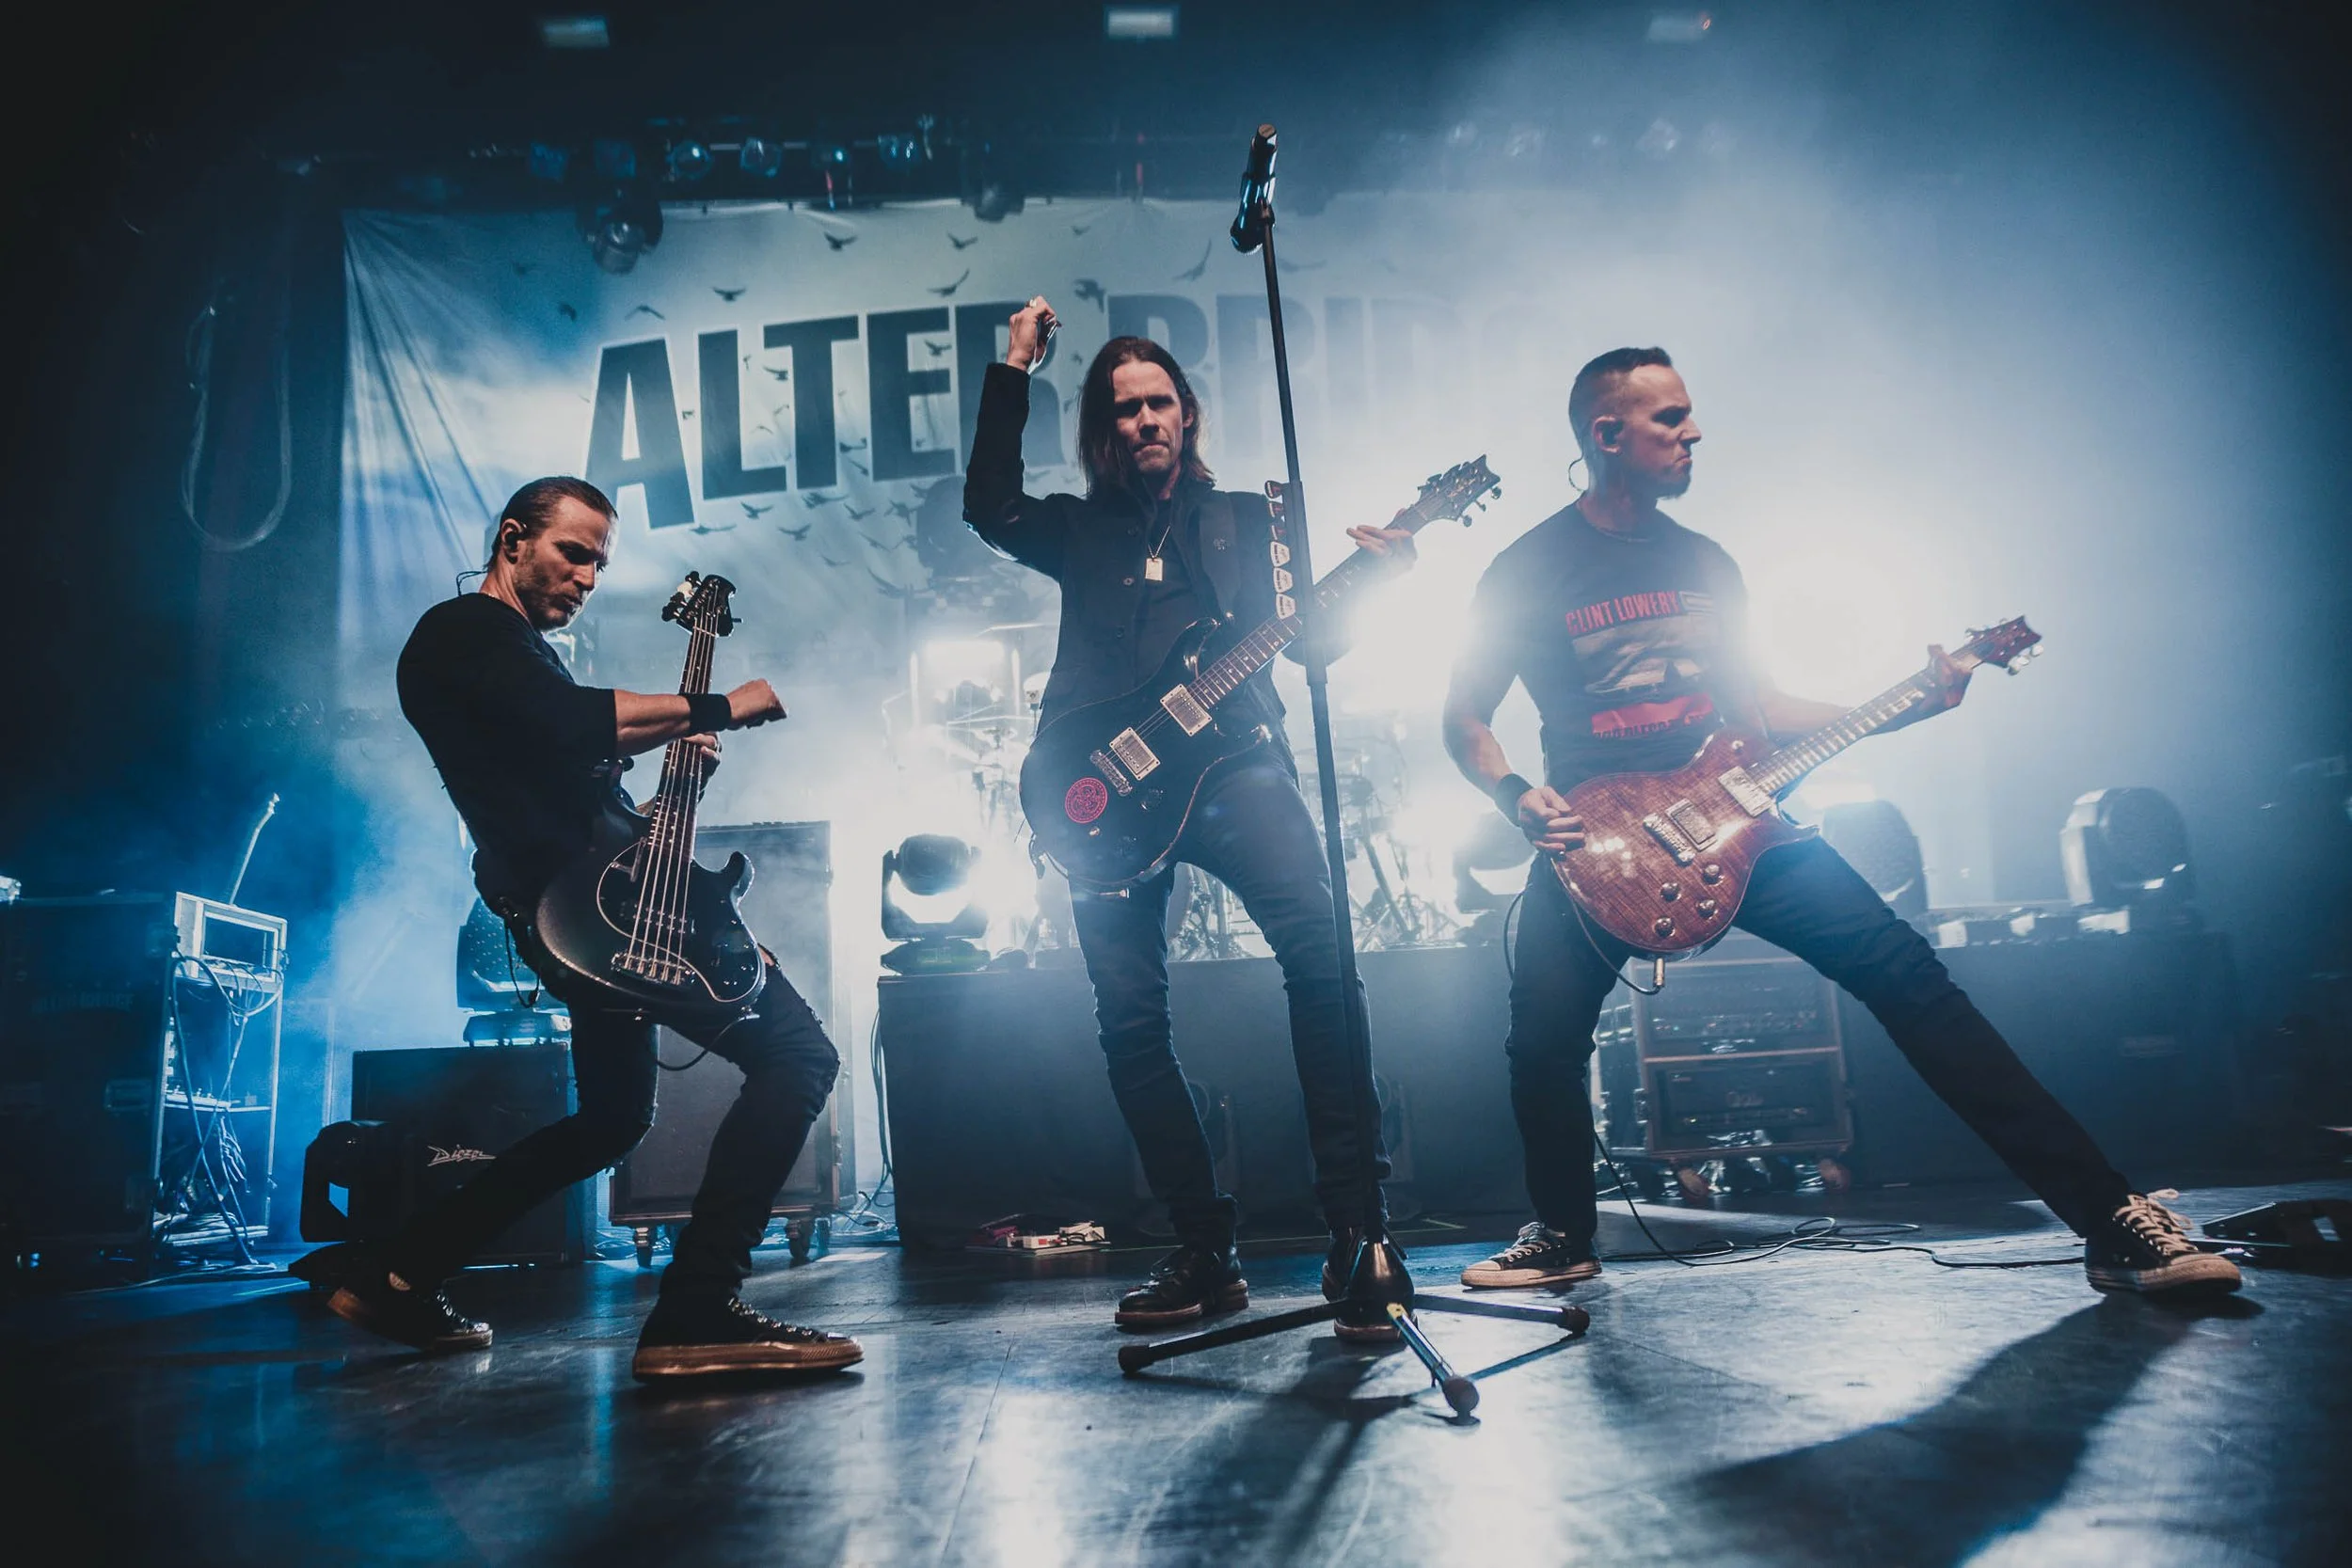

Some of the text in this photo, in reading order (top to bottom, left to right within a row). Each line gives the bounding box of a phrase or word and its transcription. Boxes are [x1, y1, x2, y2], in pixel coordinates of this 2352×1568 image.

[580, 301, 1064, 530] ALTER
[1566, 591, 1679, 634] CLINT LOWERY
